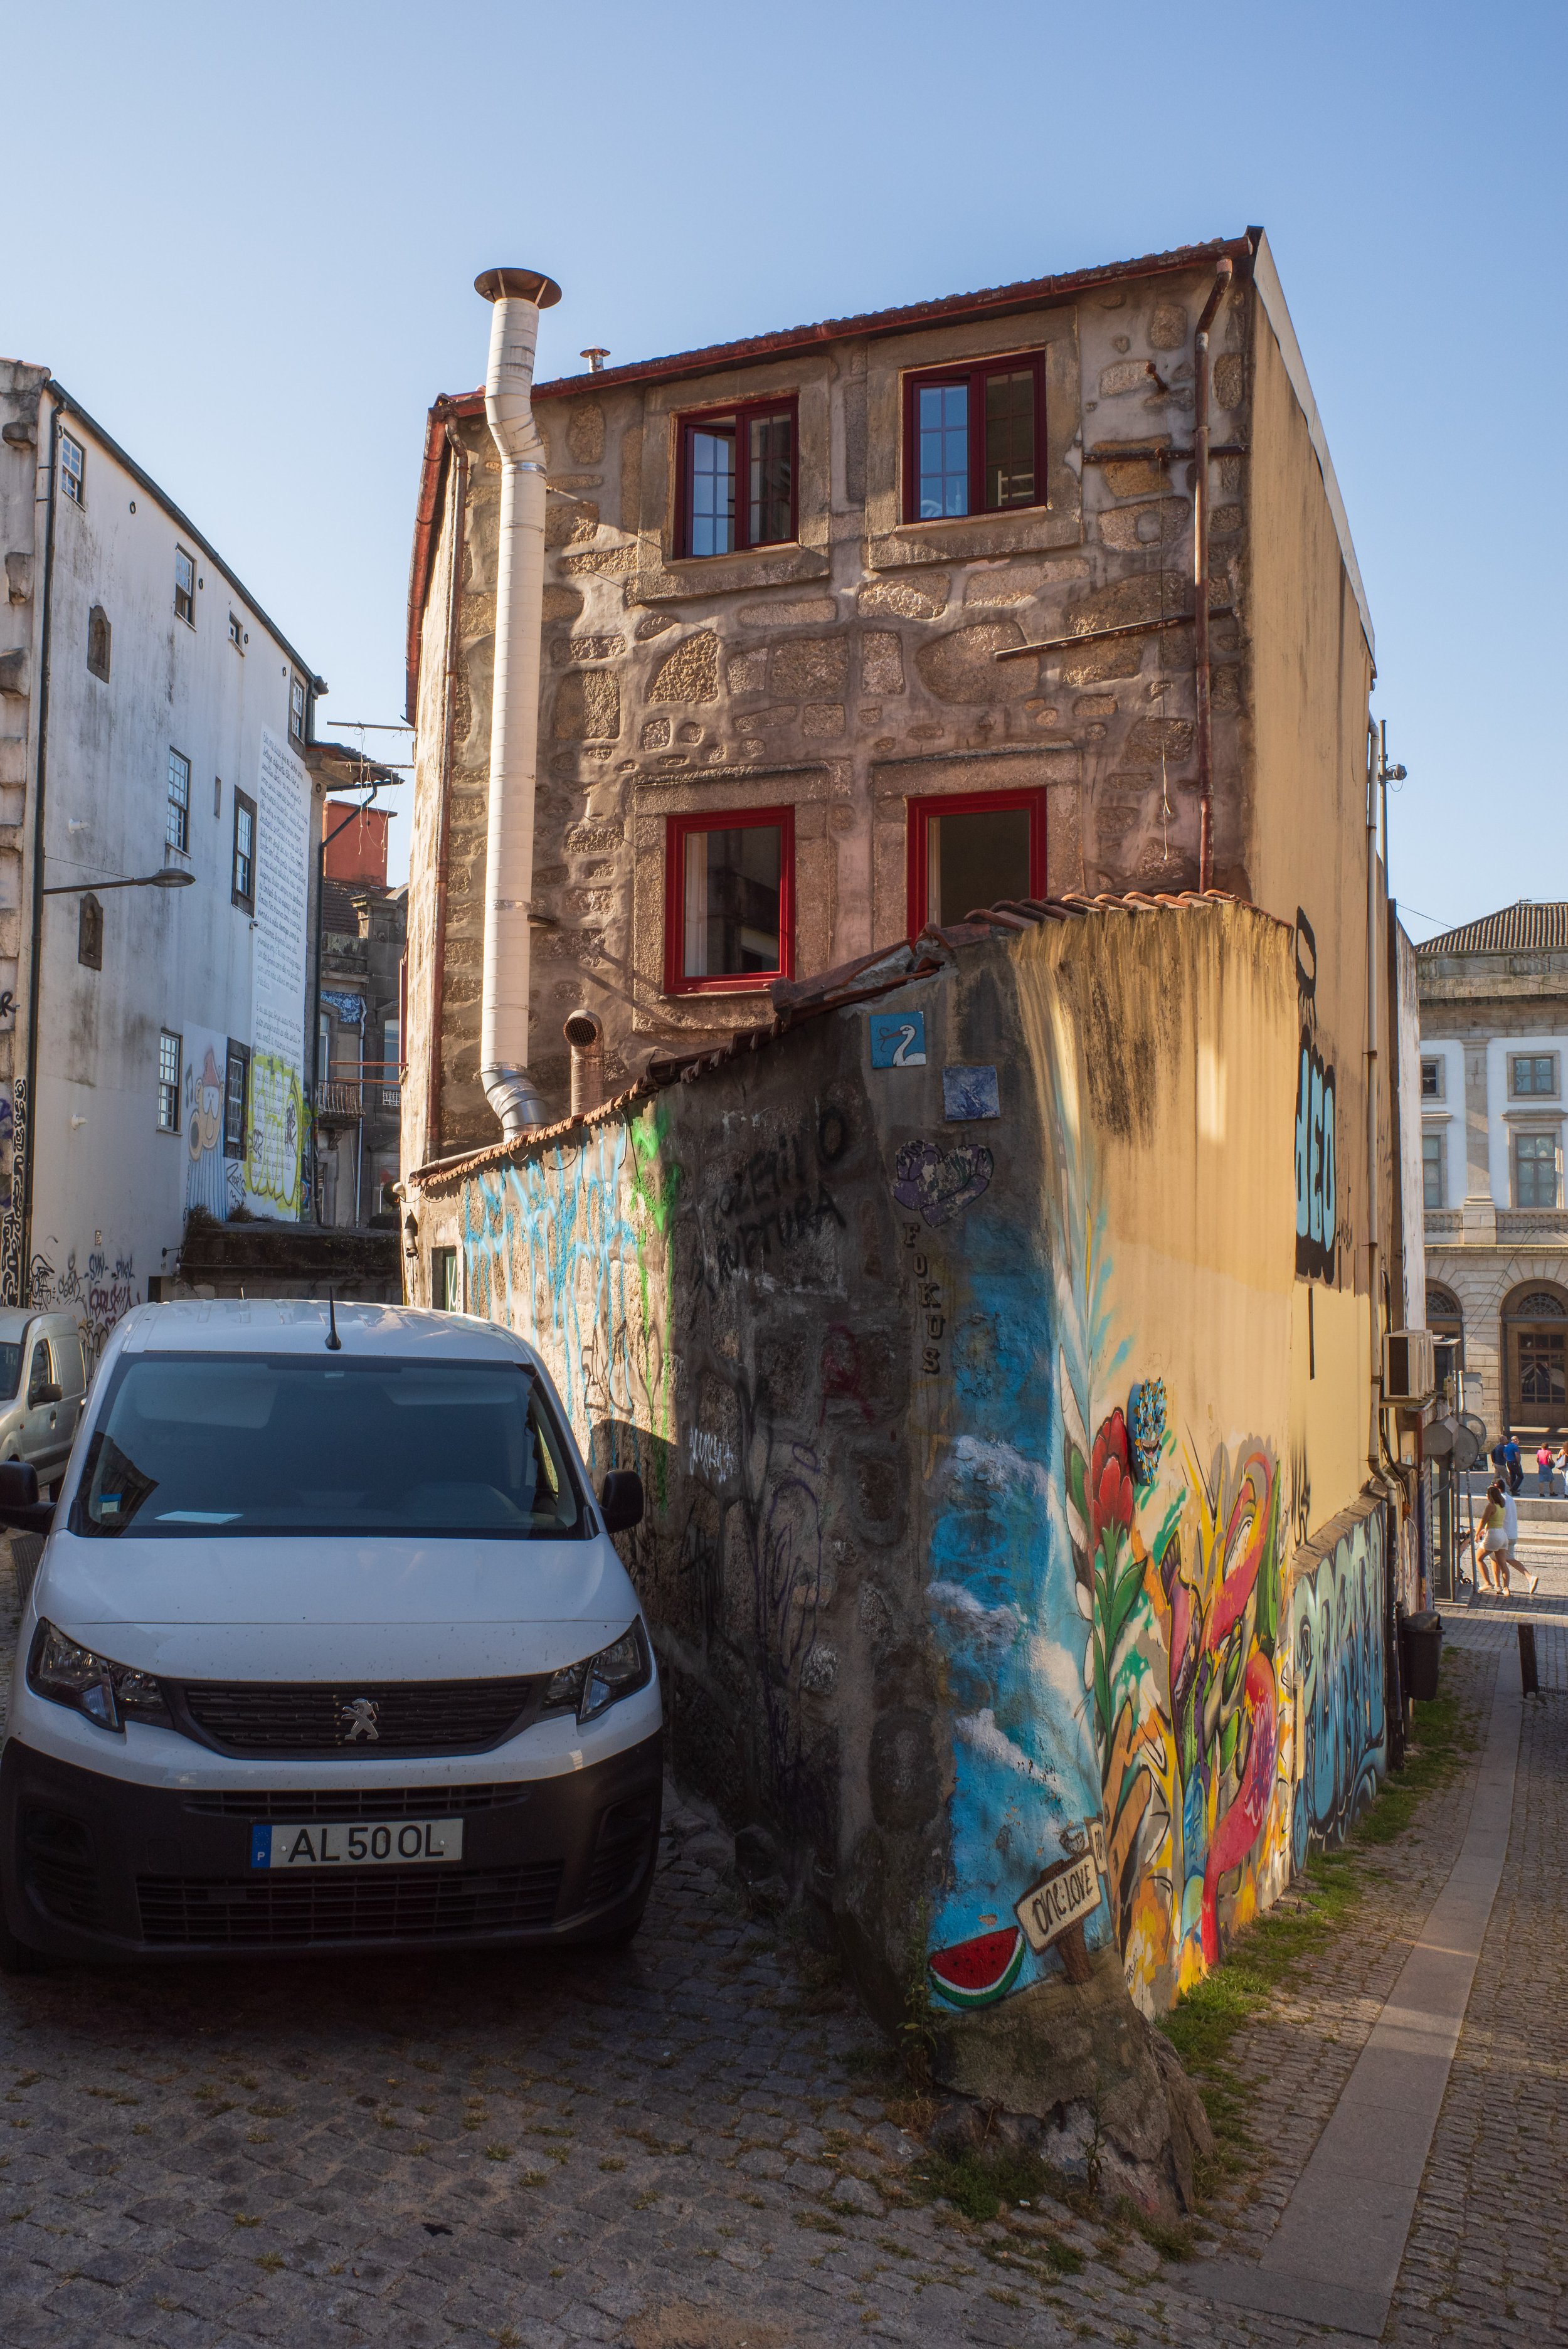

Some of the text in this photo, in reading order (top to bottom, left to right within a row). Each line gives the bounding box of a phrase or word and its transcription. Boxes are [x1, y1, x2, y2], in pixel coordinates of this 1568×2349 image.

[903, 1222, 945, 1374] FOKUS
[257, 1851, 265, 1861] P
[288, 1828, 341, 1863] AL
[347, 1826, 391, 1860] 50
[1063, 1864, 1093, 1912] LOVE
